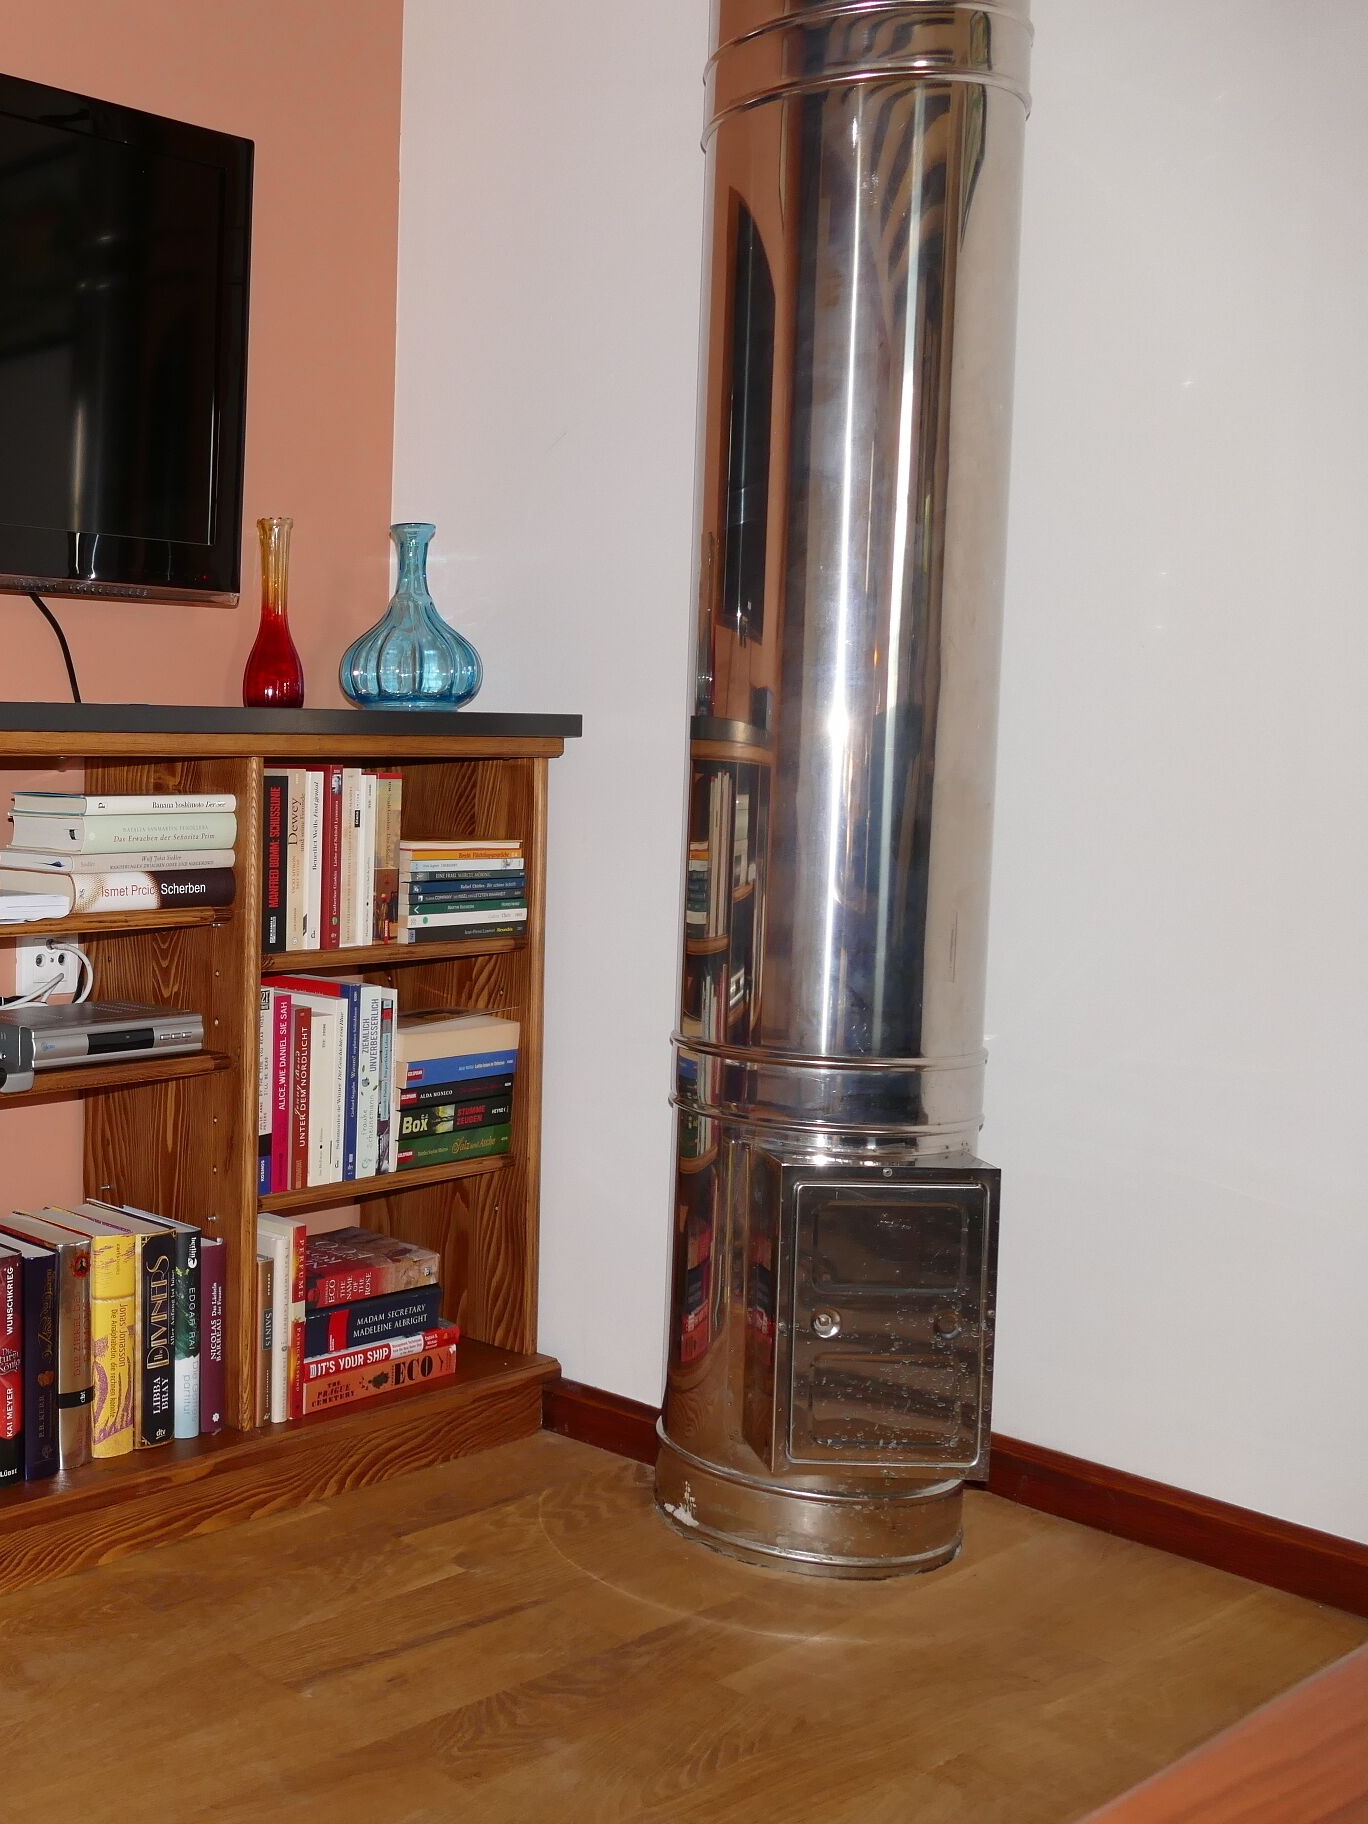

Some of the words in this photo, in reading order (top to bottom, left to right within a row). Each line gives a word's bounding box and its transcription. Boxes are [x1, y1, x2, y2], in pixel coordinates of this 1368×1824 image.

[269, 786, 281, 838] SCHUSSLINIE
[288, 797, 302, 846] Dewey
[113, 835, 126, 843] Das
[160, 834, 172, 842] der
[268, 839, 280, 868] BOMM:
[102, 885, 129, 898] Ismet
[160, 882, 206, 896] Scherben
[268, 869, 280, 908] MANFRED
[280, 1001, 288, 1020] SAH
[279, 1021, 287, 1035] SIE
[362, 1018, 371, 1054] ZIEMLICH
[370, 998, 379, 1072] UNVERBESSERLICH
[279, 1036, 287, 1068] DANIEL
[300, 1026, 308, 1087] NORDLICHT
[278, 1068, 286, 1084] WIE
[278, 1083, 287, 1111] ALICE,
[299, 1089, 307, 1111] DEM
[456, 1114, 484, 1126] ZEUGEN
[457, 1104, 488, 1116] STUMME
[299, 1115, 307, 1147] UNTER
[402, 1115, 429, 1134] Box
[297, 1239, 306, 1298] PERFUME
[328, 1279, 336, 1303] ECO
[353, 1282, 357, 1292] OF
[6, 1266, 14, 1336] WUNSCHKRIEG
[110, 1308, 118, 1319] Die
[146, 1255, 169, 1370] DIVINERS
[188, 1287, 196, 1327] EDGAR
[119, 1303, 128, 1327] Jonas
[353, 1323, 393, 1338] MADELEINE
[393, 1313, 428, 1329] ALBRIGHT
[356, 1313, 385, 1327] MADAM
[387, 1303, 427, 1319] SECRETARY
[72, 1314, 81, 1353] ZIRKEL
[109, 1320, 119, 1361] Analphabetin,
[188, 1331, 196, 1350] RAI
[264, 1311, 273, 1348] SAINTS
[119, 1329, 128, 1368] Jonasson
[72, 1355, 81, 1377] DER
[110, 1362, 118, 1372] die
[317, 1360, 336, 1376] IT'S
[338, 1353, 364, 1371] YOUR
[366, 1347, 389, 1364] SHIP
[394, 1354, 434, 1386] ECO
[110, 1372, 118, 1397] rechnen
[152, 1376, 161, 1414] LIBBA
[161, 1377, 169, 1410] BRAY
[183, 1373, 192, 1416] partitur
[317, 1384, 351, 1399] PRAGUE
[327, 1380, 341, 1389] THE
[6, 1387, 14, 1420] MEYER
[109, 1397, 118, 1418] konnte
[311, 1390, 356, 1408] CEMETERY
[6, 1421, 14, 1438] KAI
[155, 1427, 166, 1438] dtv
